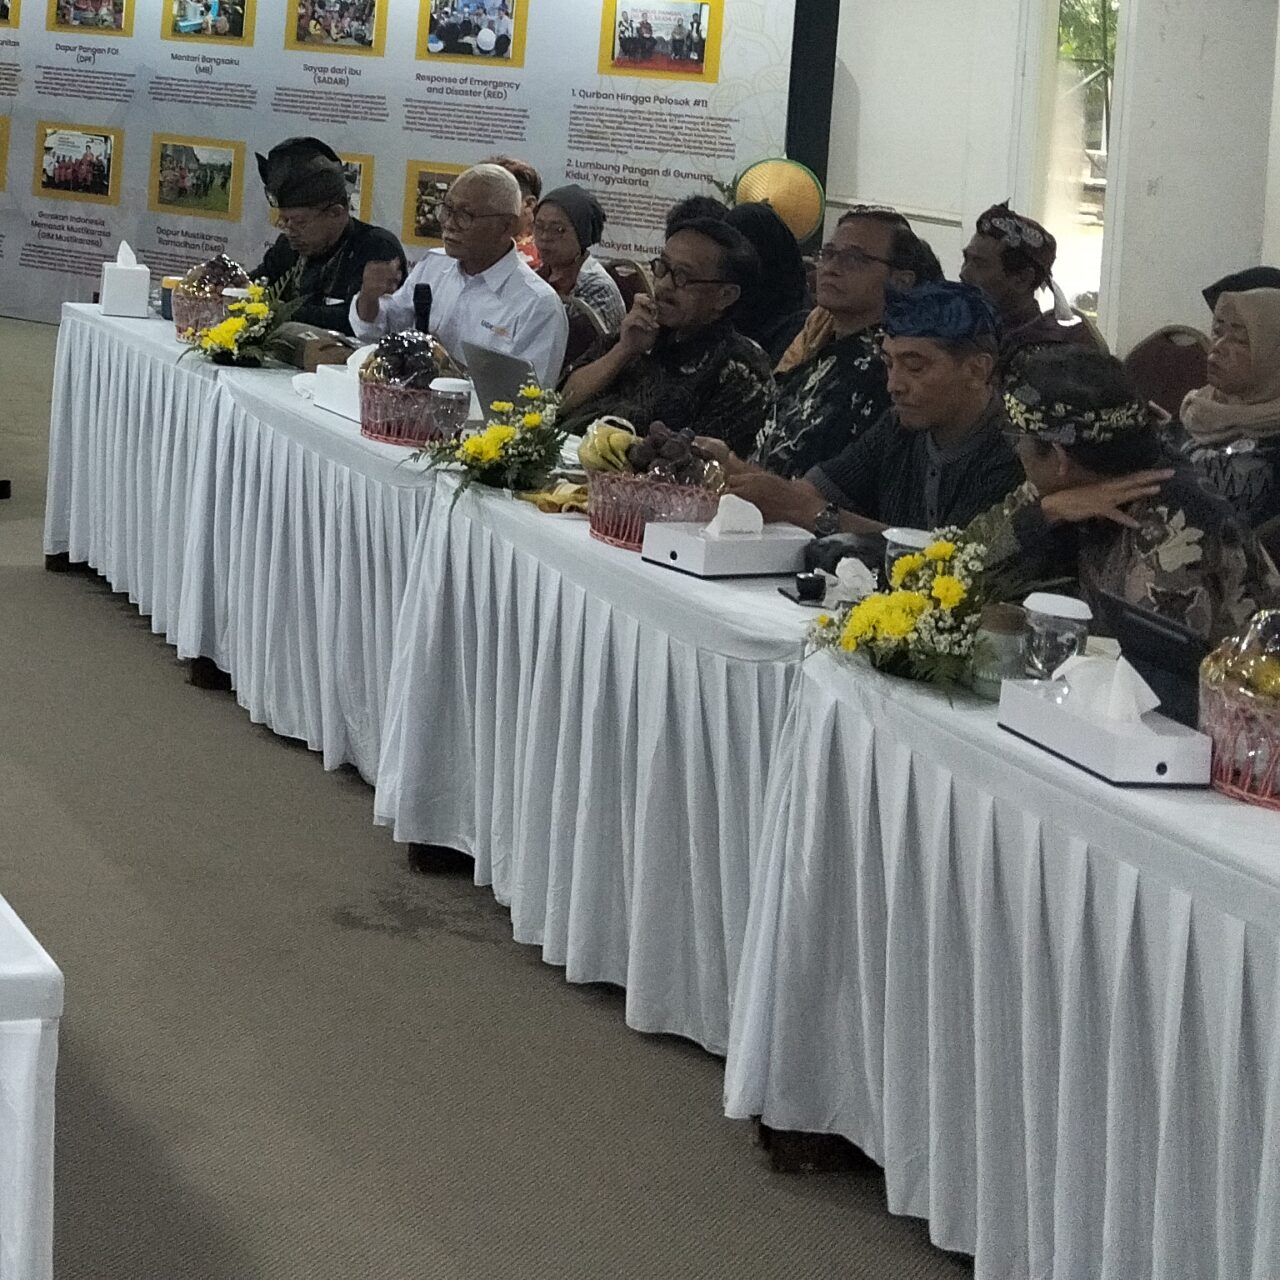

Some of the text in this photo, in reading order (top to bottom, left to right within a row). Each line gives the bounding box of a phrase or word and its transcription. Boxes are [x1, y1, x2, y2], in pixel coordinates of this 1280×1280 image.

[303, 63, 329, 75] Sayap
[330, 65, 347, 75] dari
[415, 72, 521, 91] Response of Emergency
[426, 85, 508, 101] and Disaster (RED)
[579, 89, 615, 101] Qurban
[616, 93, 652, 105] Hingga
[653, 95, 690, 107] Pelosok
[575, 160, 621, 174] Lumbung
[622, 164, 660, 177] Pangan
[661, 166, 672, 178] di
[592, 173, 650, 187] Yogyakarta
